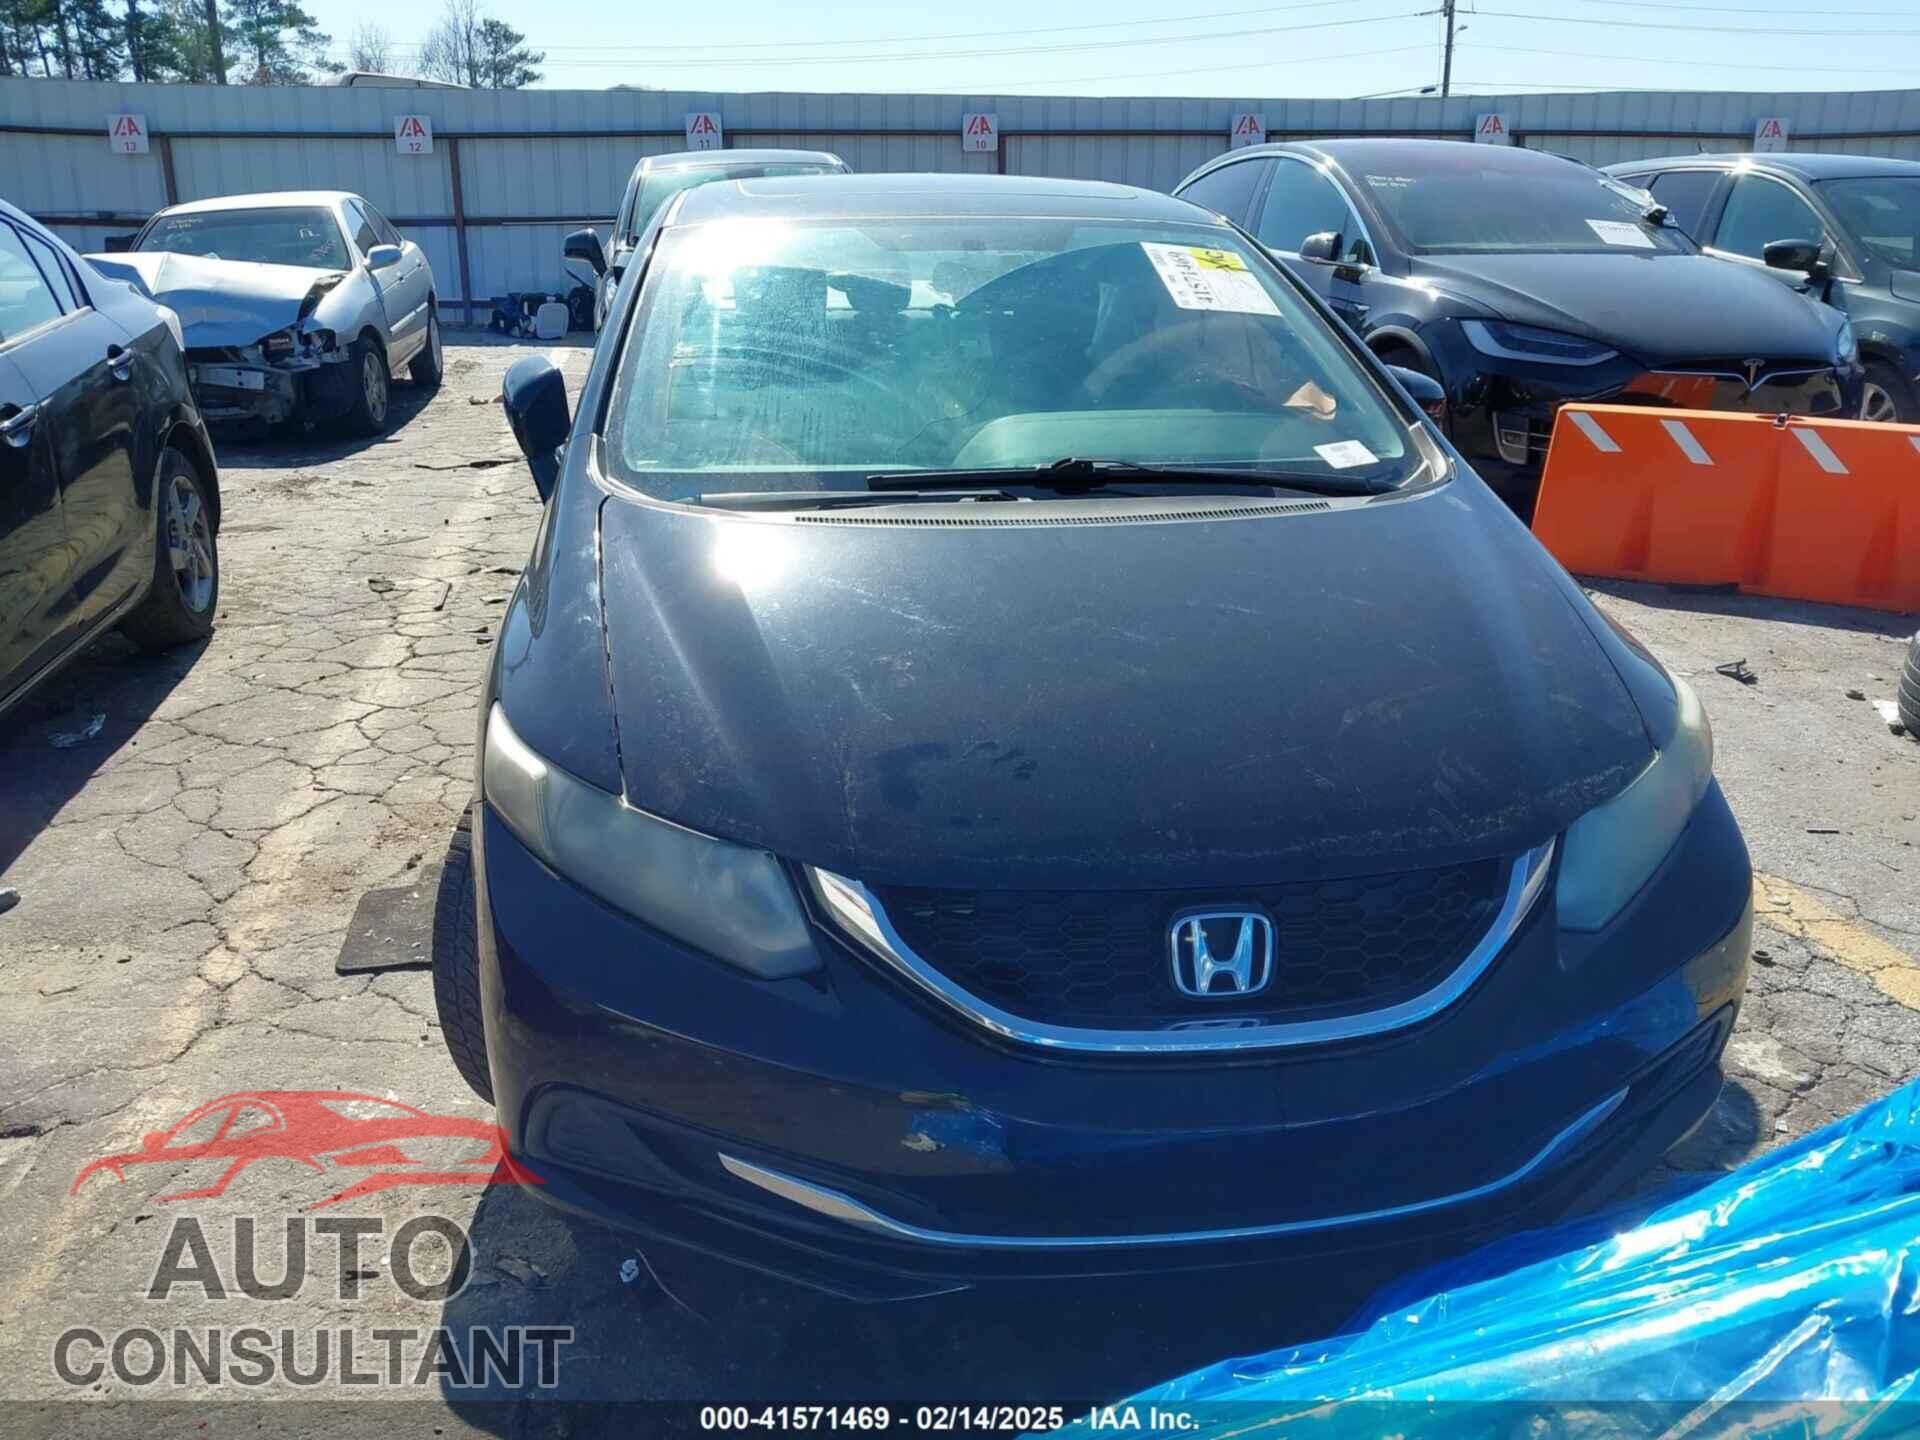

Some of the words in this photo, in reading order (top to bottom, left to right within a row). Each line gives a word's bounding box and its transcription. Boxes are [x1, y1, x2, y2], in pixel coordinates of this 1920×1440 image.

[409, 142, 424, 152] 12
[698, 139, 711, 151] 11
[975, 139, 987, 150] 10
